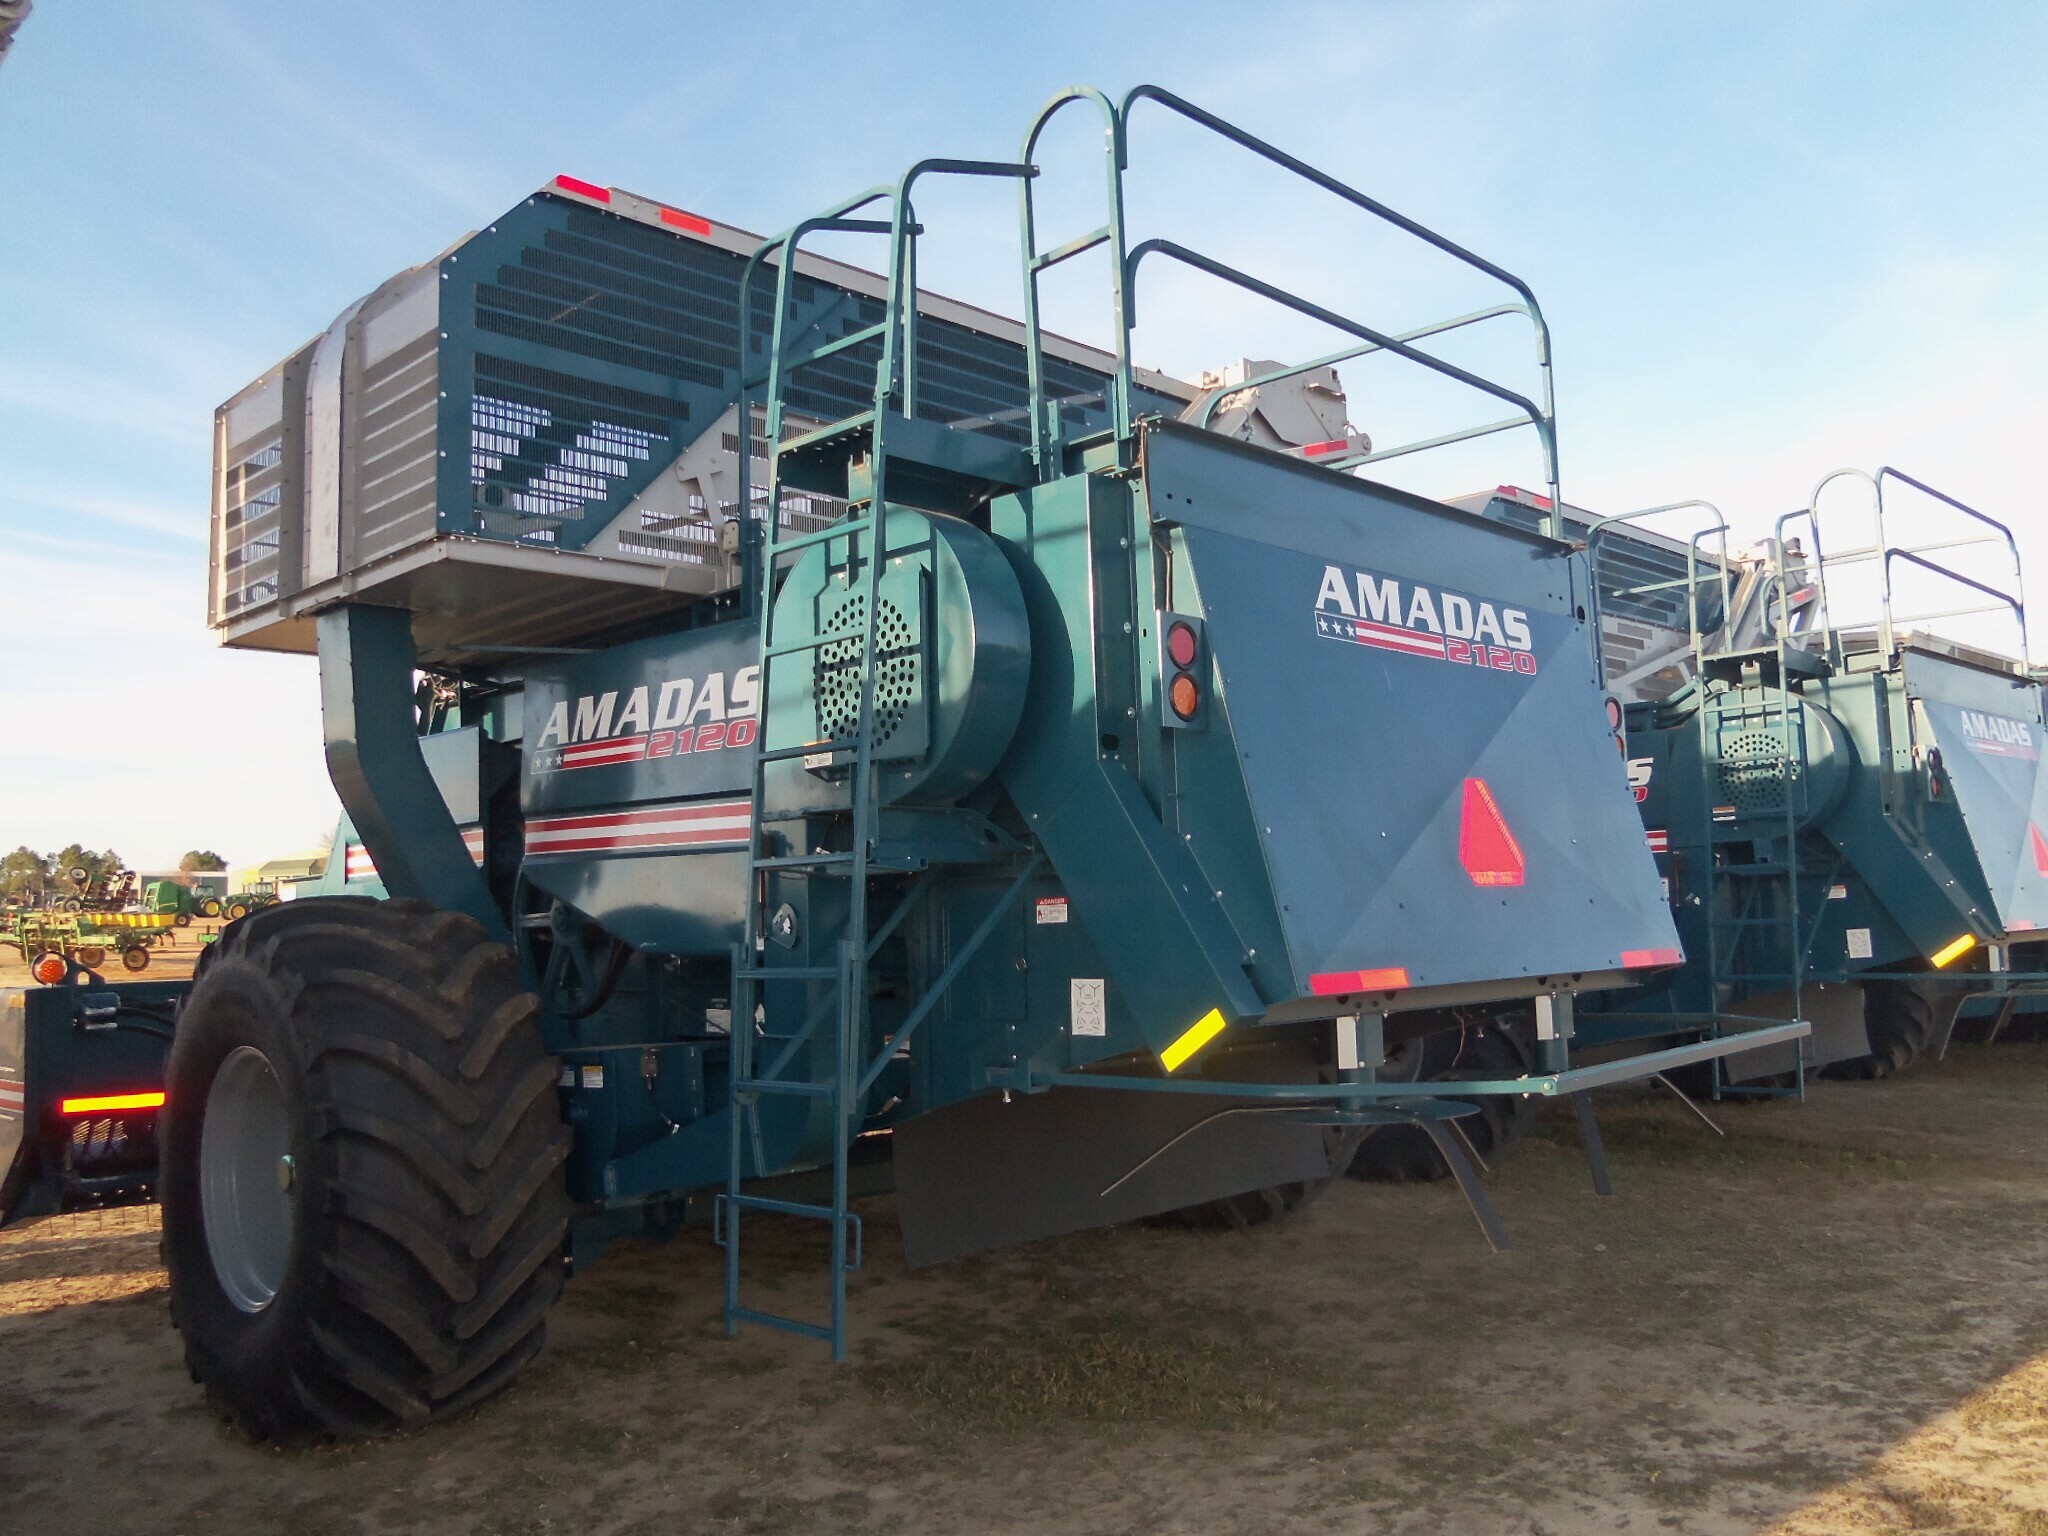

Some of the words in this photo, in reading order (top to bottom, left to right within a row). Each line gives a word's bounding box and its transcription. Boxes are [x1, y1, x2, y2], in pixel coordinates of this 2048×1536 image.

[1315, 565, 1532, 651] AMADAS
[1446, 637, 1537, 675] 2120
[536, 665, 760, 748] AMADAS
[646, 718, 758, 760] 2120
[1960, 710, 2033, 747] AMADAS
